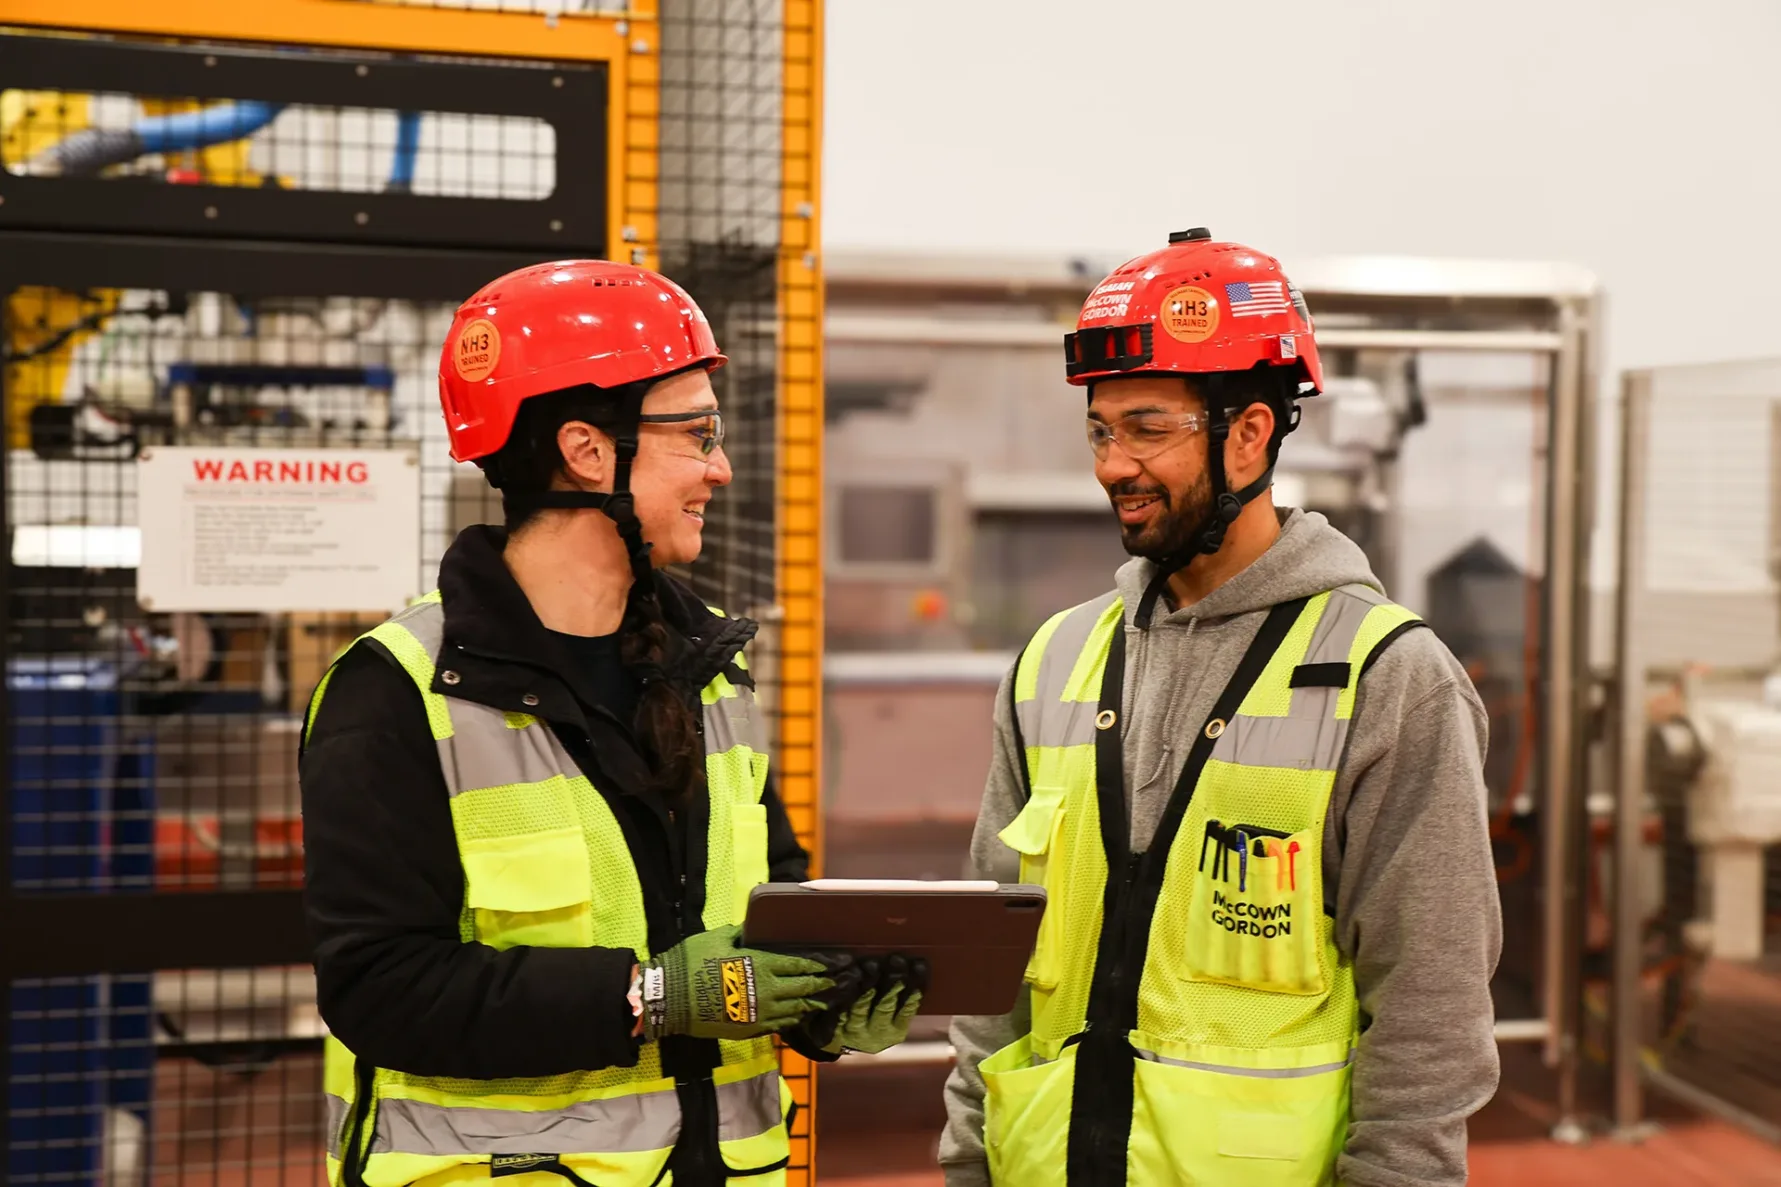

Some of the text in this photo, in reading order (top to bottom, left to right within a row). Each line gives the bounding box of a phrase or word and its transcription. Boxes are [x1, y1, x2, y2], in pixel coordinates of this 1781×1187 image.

[1095, 282, 1136, 296] ISAIAH
[1082, 305, 1128, 321] GORDON
[1172, 301, 1208, 316] NH3
[1172, 318, 1209, 328] TRAINED
[461, 333, 489, 356] NH3
[193, 459, 369, 484] WARNING
[1213, 890, 1291, 921] McCOWN
[1212, 909, 1291, 939] GORDON
